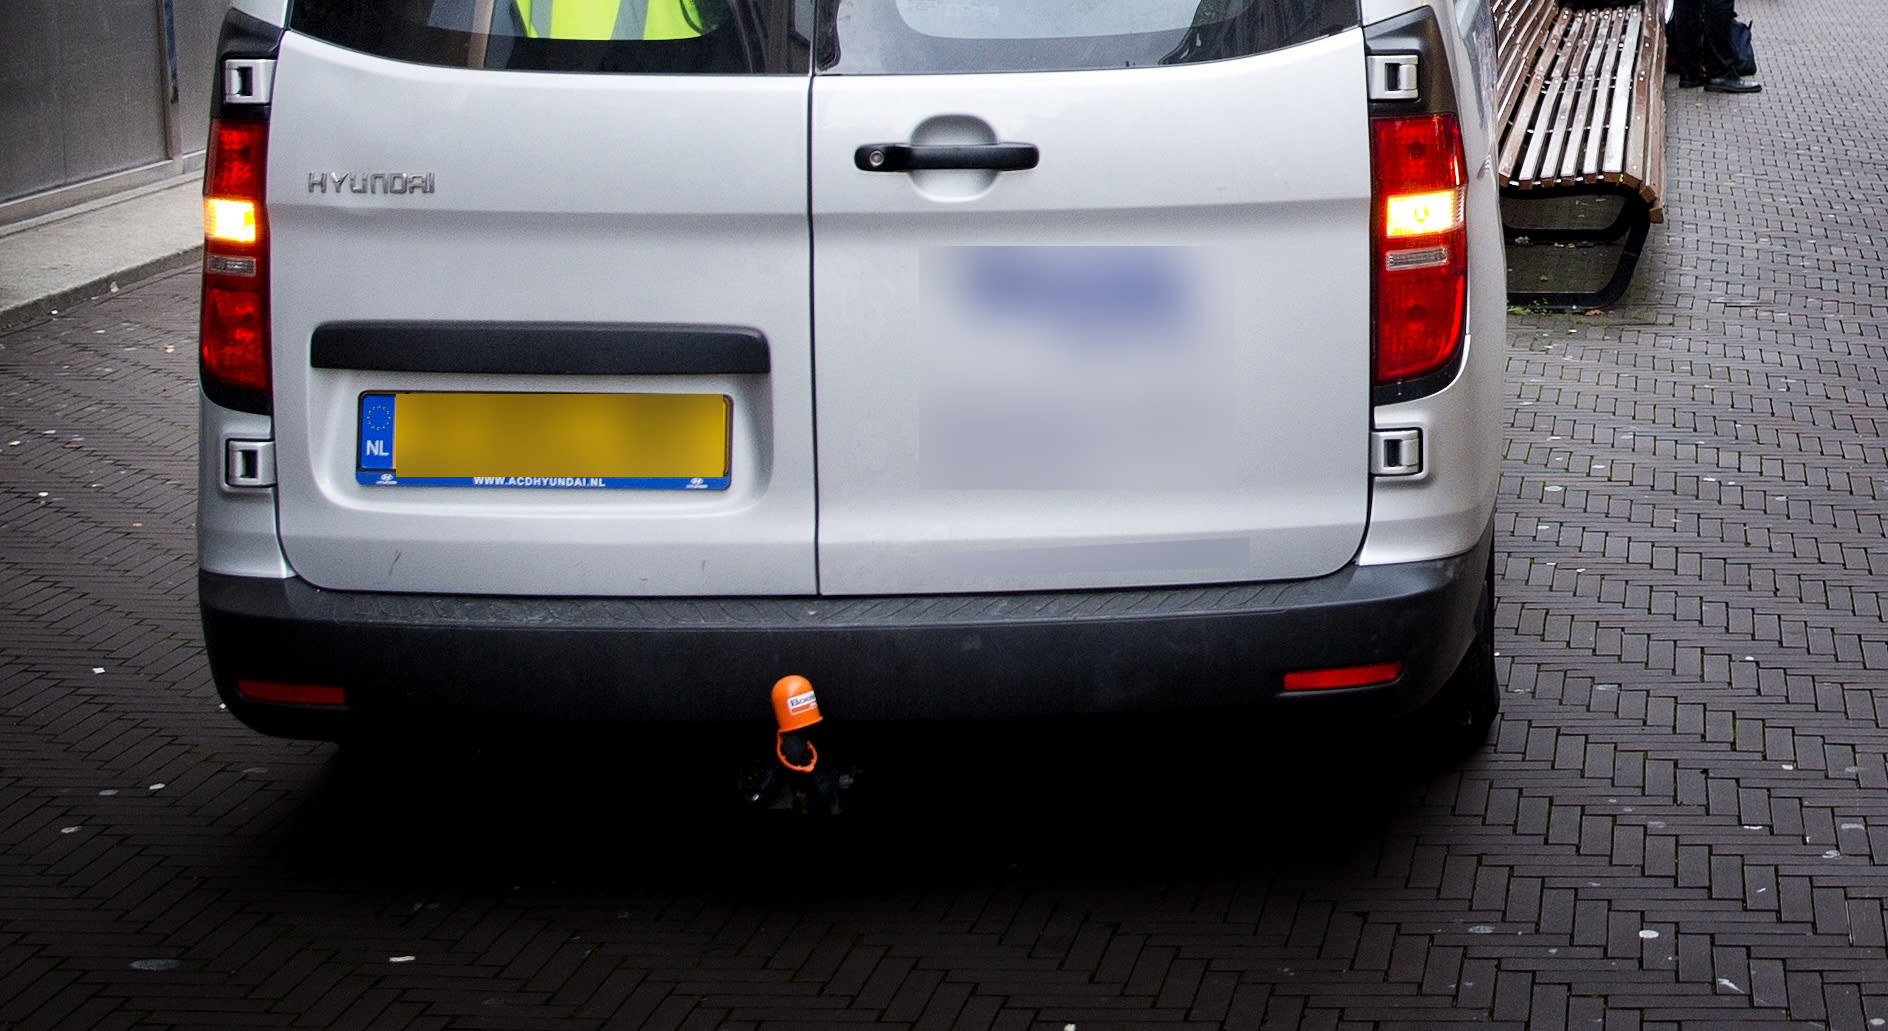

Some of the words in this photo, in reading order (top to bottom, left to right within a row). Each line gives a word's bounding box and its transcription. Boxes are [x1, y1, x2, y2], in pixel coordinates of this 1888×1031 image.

[308, 172, 435, 194] HYUNDAI
[366, 440, 389, 456] NL
[473, 476, 606, 488] WWW.ACDHYUNDAI.NL
